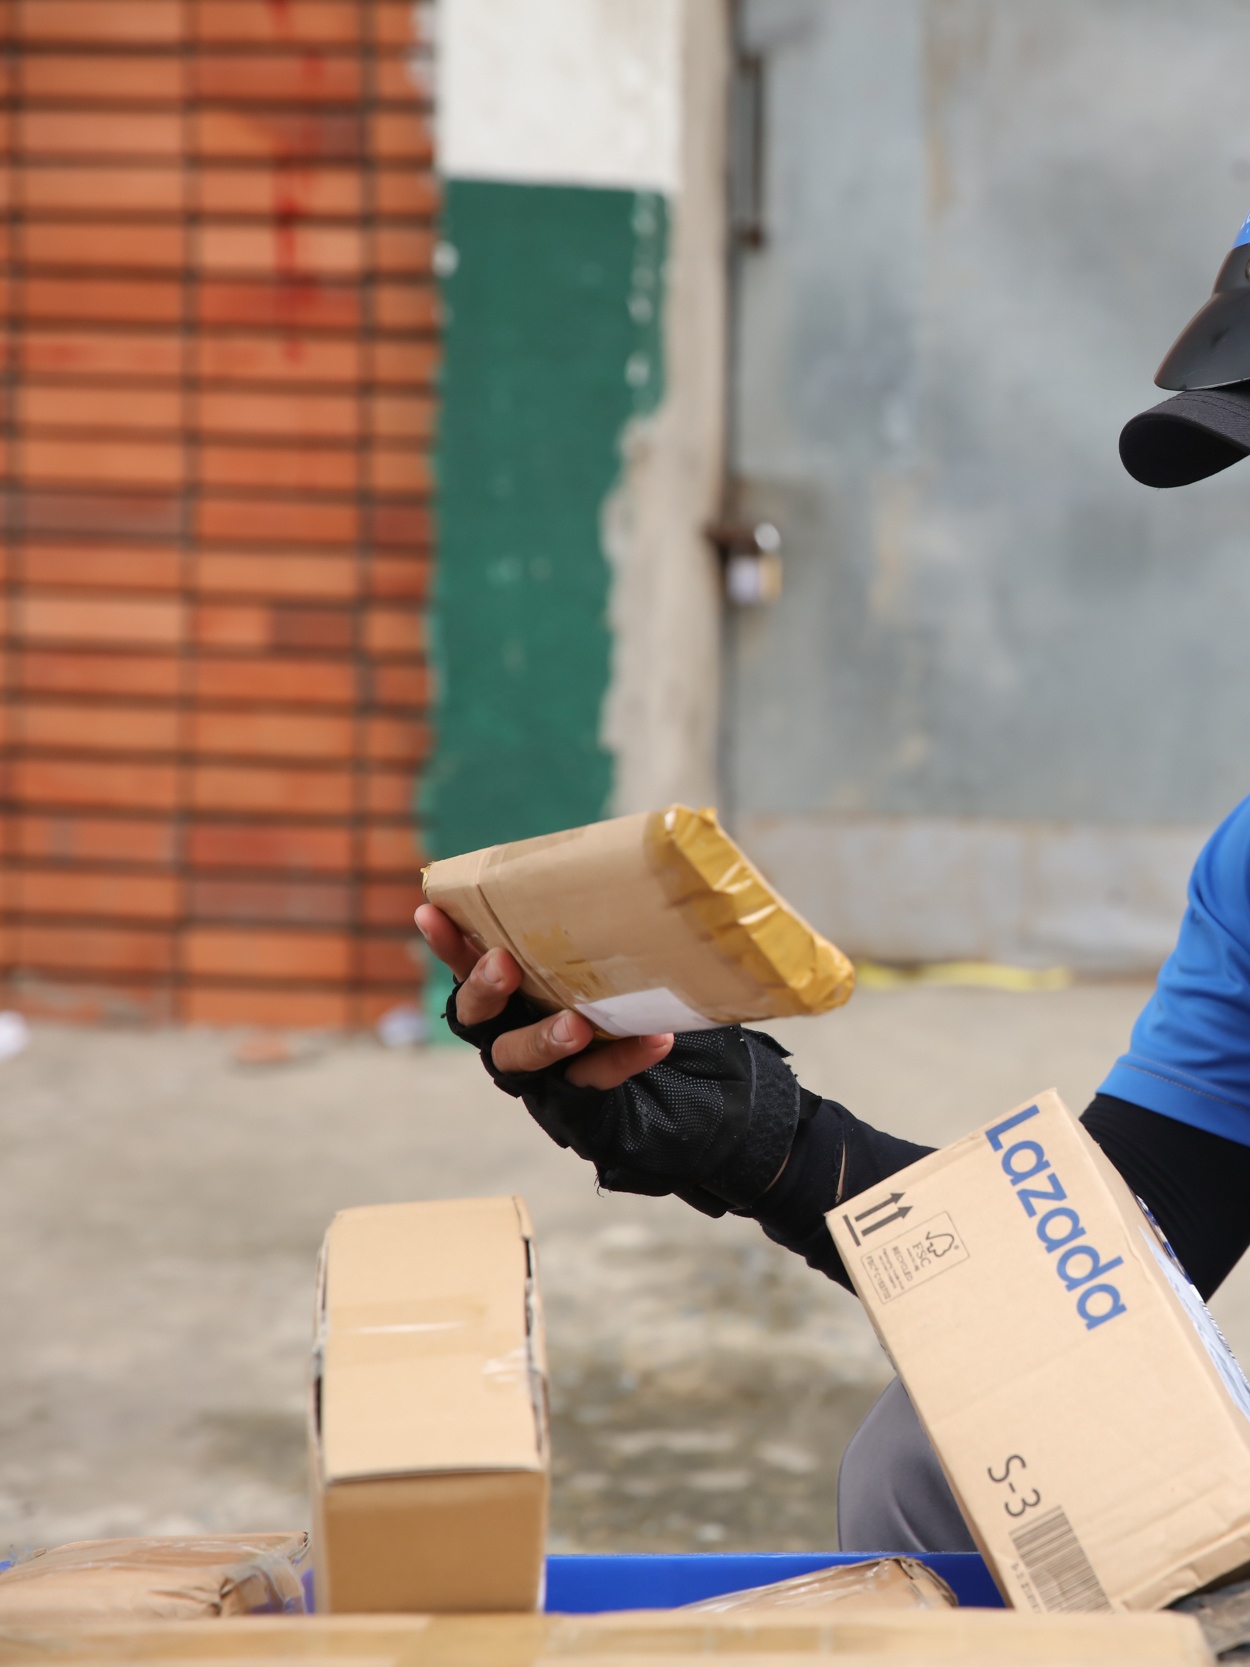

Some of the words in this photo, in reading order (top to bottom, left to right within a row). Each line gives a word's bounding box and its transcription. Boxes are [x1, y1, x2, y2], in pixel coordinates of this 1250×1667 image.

[985, 1104, 1127, 1331] Lazada
[912, 1241, 932, 1268] FSC
[987, 1454, 1041, 1517] S-3
